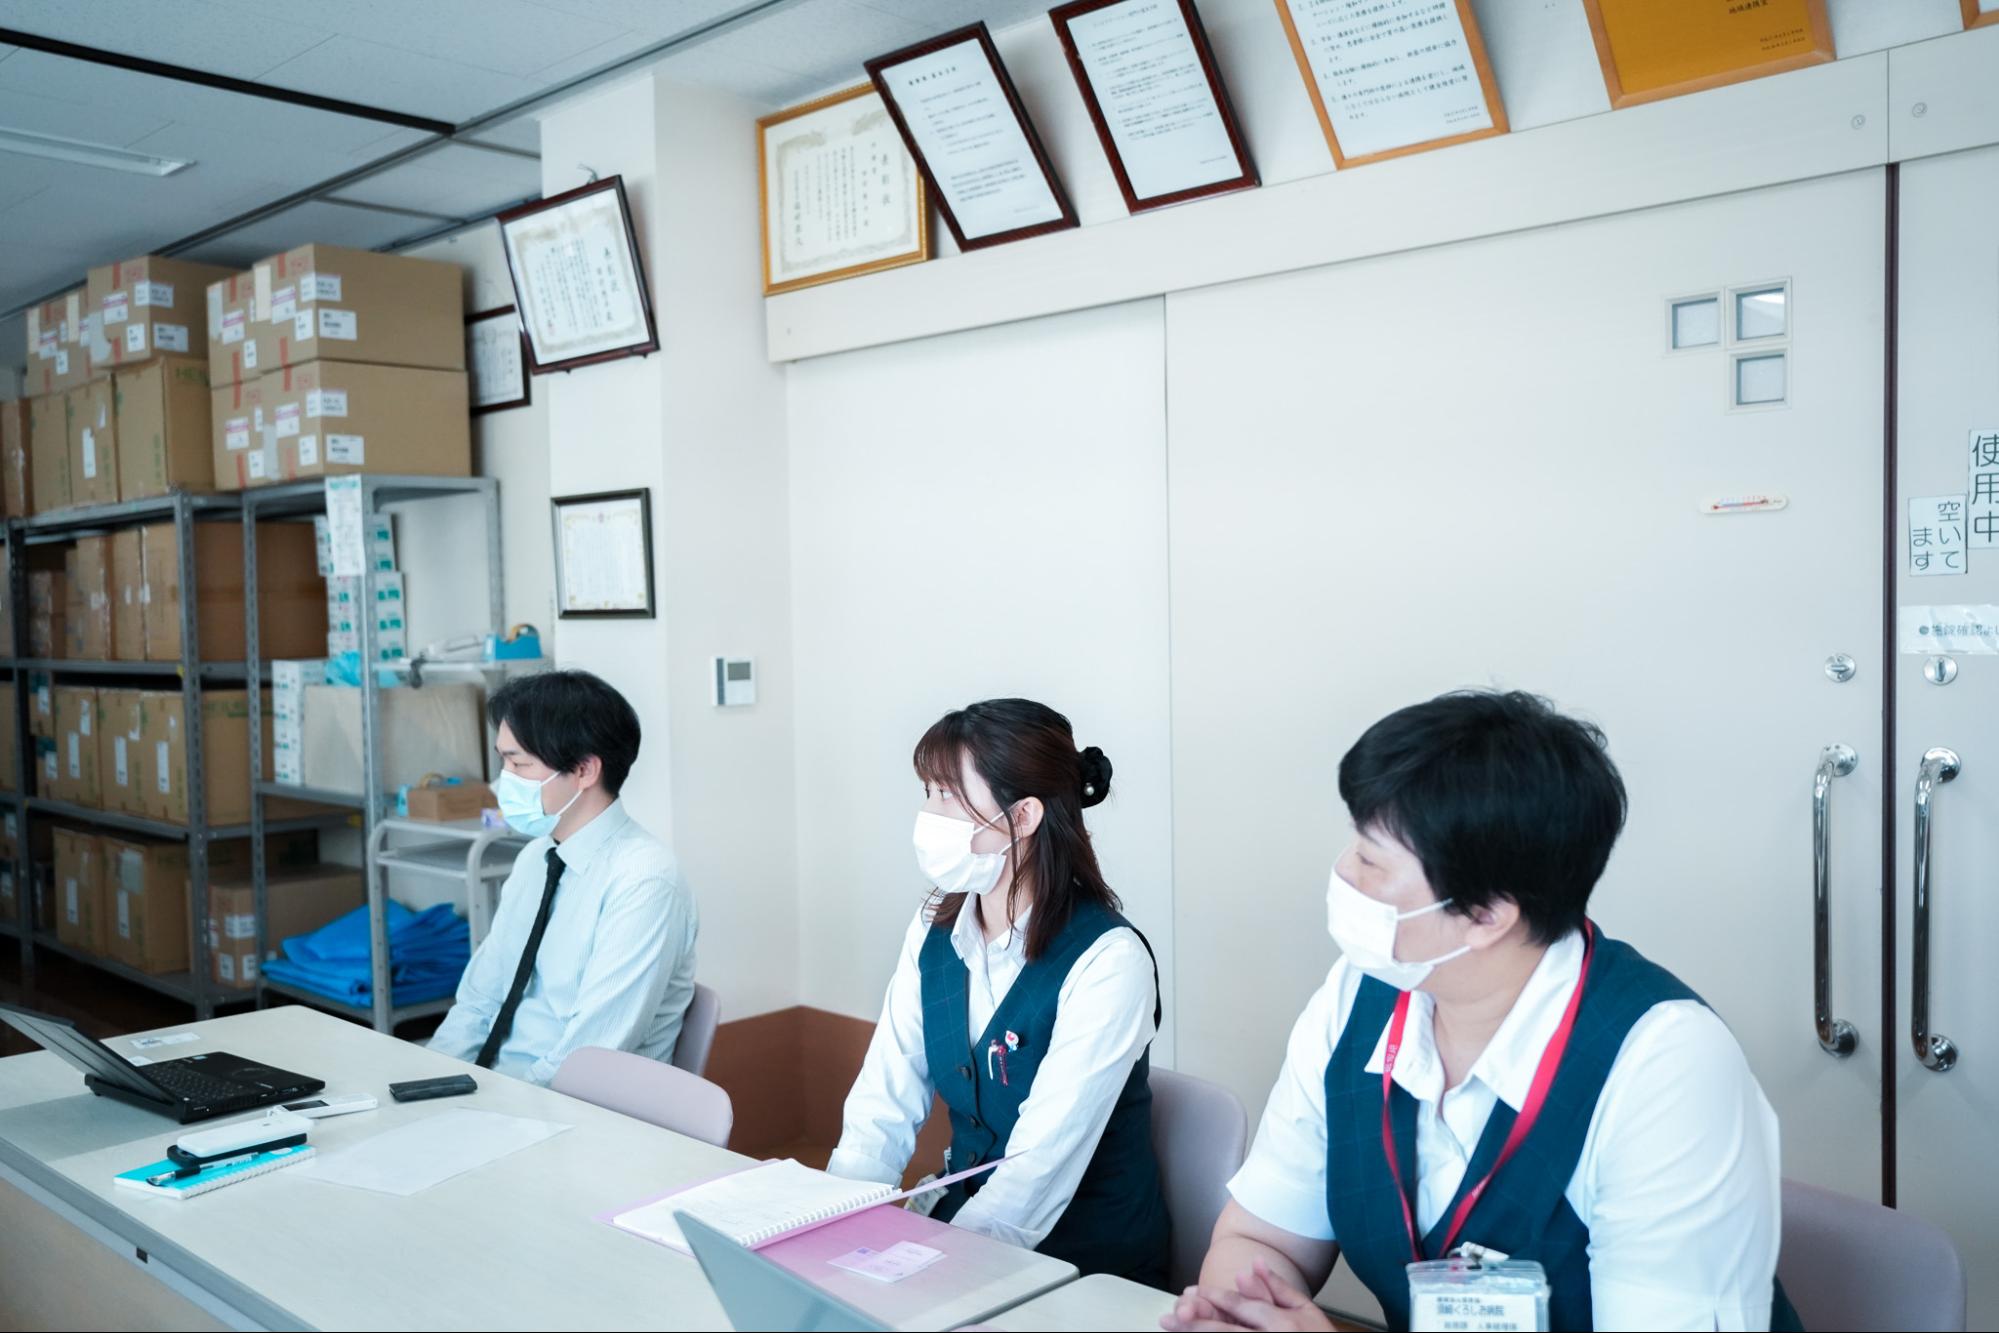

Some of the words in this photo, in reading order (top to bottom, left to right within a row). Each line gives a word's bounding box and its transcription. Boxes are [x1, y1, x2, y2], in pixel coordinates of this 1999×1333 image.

[1972, 433, 1999, 543] 使用中
[1912, 527, 1934, 571] ます
[1937, 500, 1962, 569] 空いて
